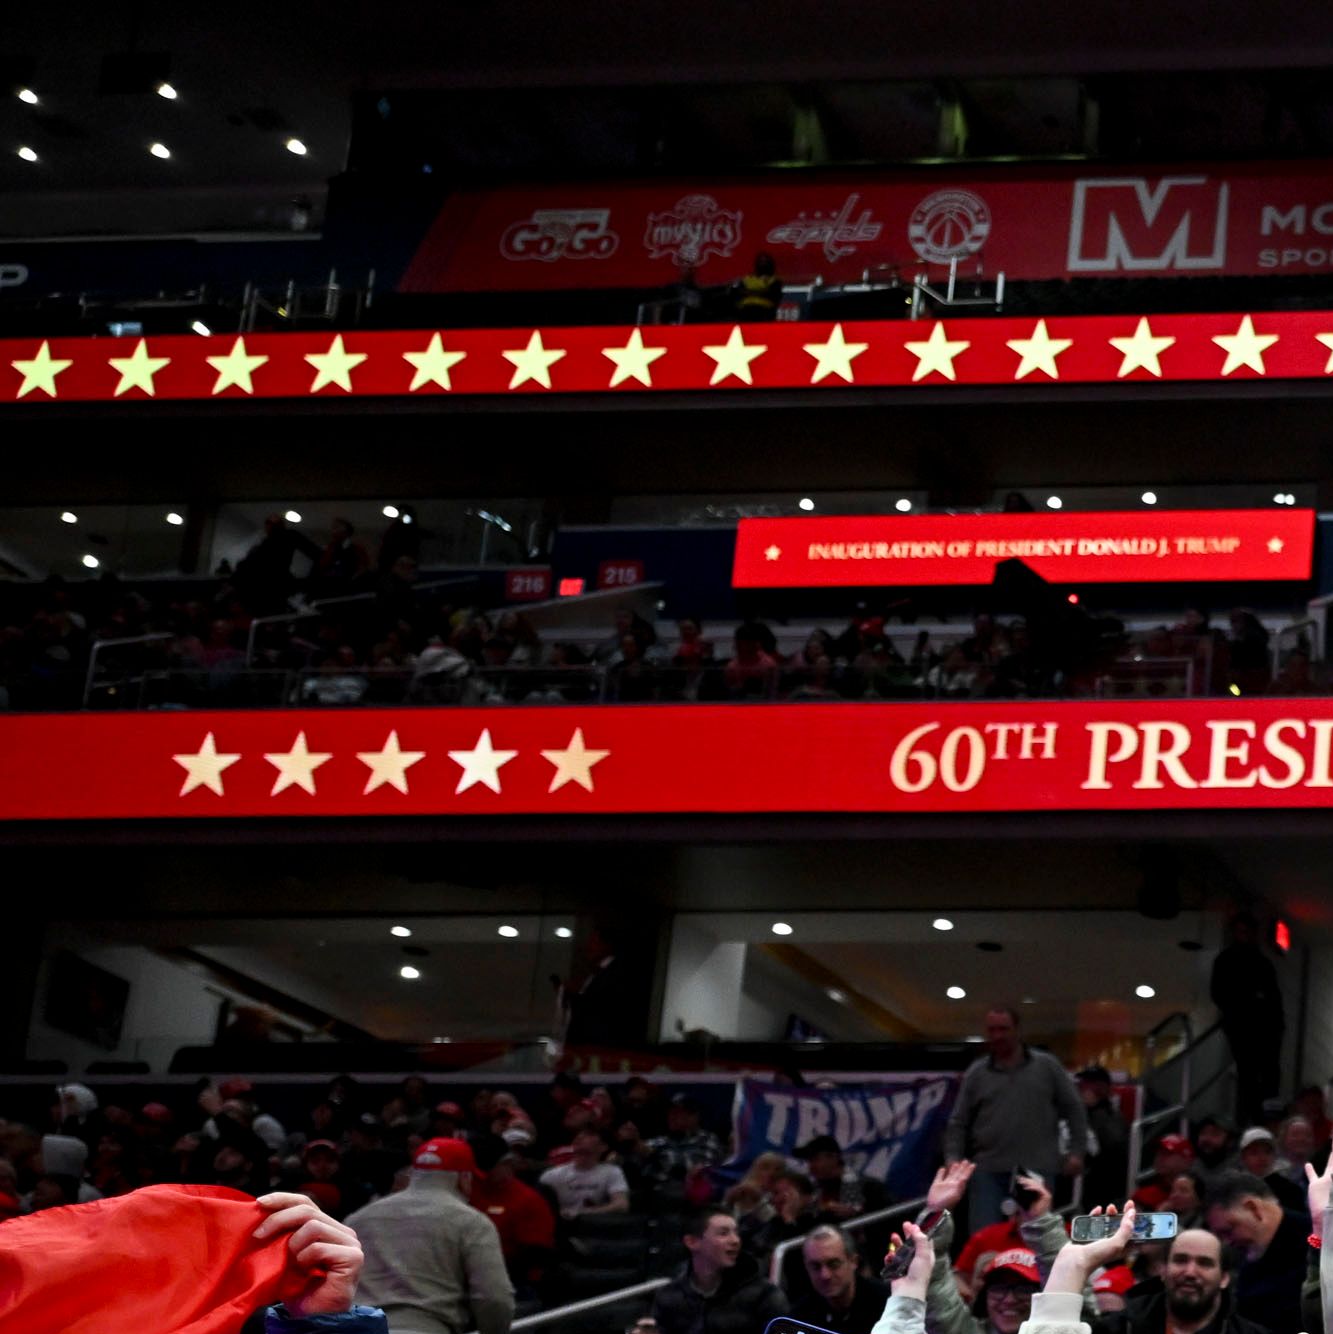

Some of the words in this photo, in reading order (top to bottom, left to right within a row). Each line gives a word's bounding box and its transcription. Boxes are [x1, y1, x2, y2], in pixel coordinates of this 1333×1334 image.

[808, 542, 944, 561] INAUGURATION
[946, 542, 973, 558] OF
[975, 539, 1076, 558] PRESIDENT
[1077, 538, 1156, 557] DONALD
[1173, 537, 1241, 555] TRUMP
[889, 721, 1058, 793] 60TH
[763, 1079, 948, 1151] TRUMP
